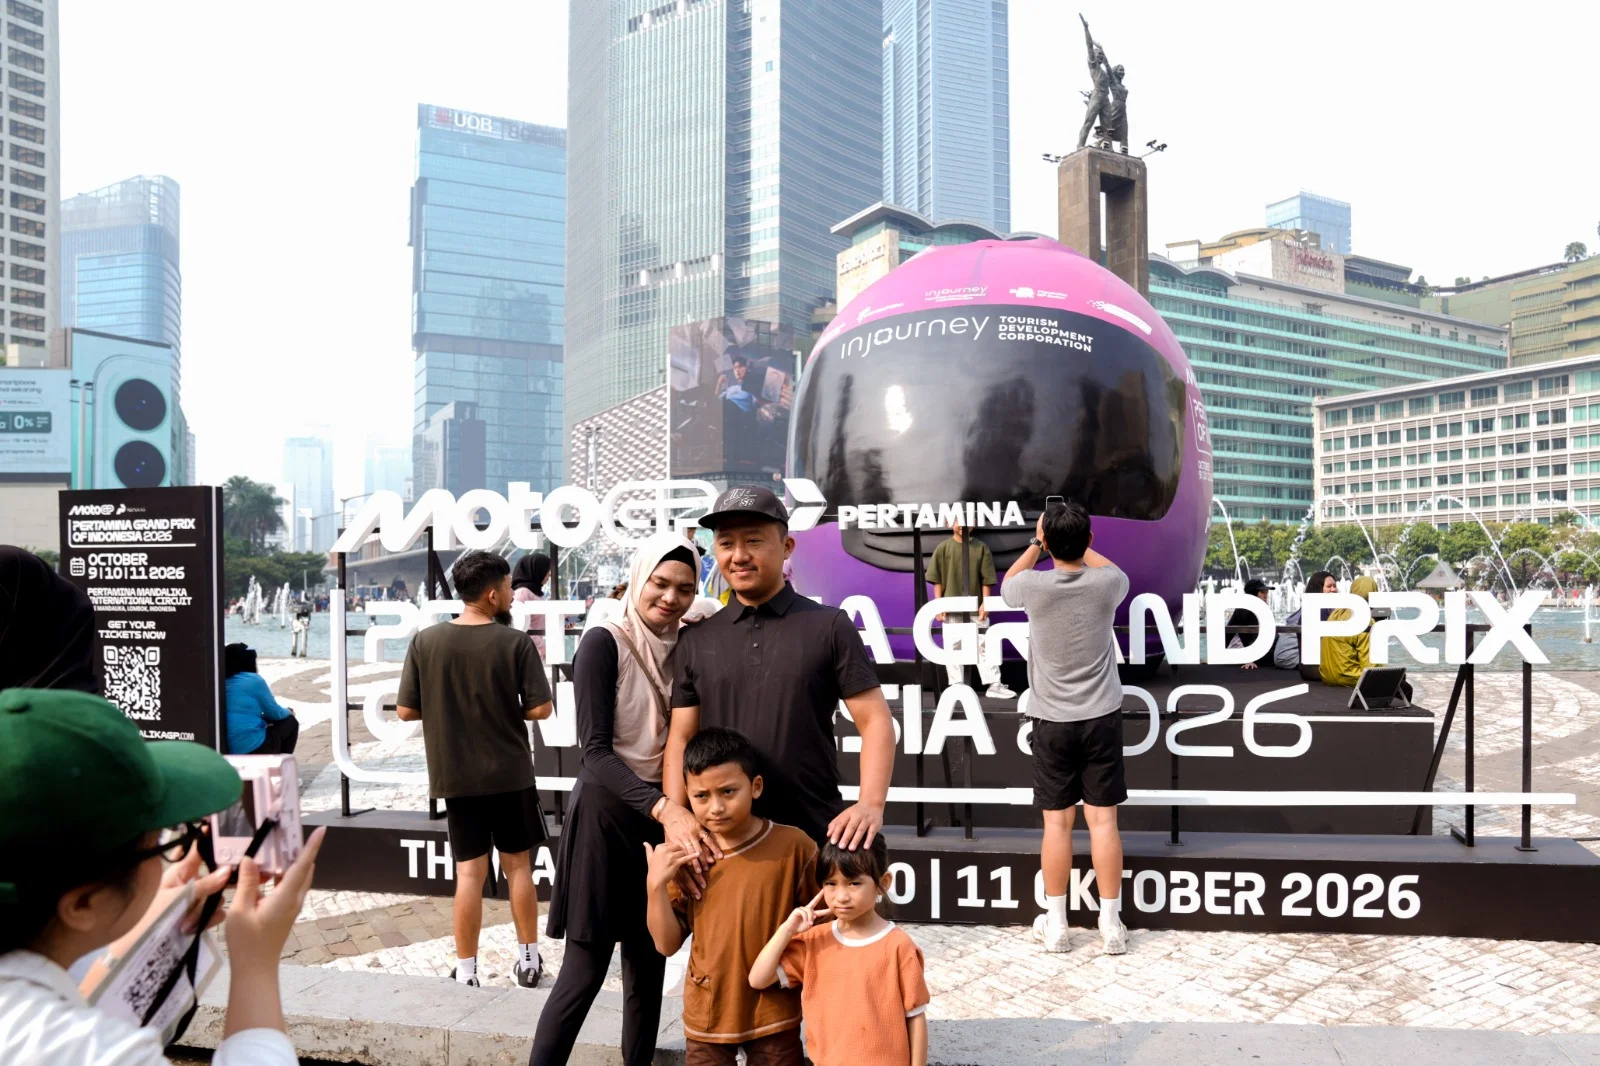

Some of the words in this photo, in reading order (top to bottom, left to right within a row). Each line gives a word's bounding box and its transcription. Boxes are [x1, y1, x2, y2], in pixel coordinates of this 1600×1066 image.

[454, 112, 493, 132] UOB
[1000, 315, 1058, 328] TOURISM
[840, 316, 990, 359] injourney
[998, 324, 1094, 344] DEVELOPMENT
[998, 332, 1092, 353] CORPORATION
[14, 415, 34, 429] 0%
[68, 504, 115, 516] MotoGP
[330, 479, 720, 552] MotoGP
[838, 500, 1025, 530] PERTAMINA
[72, 519, 133, 531] PERTAMINA
[133, 518, 170, 530] GRAND
[170, 518, 196, 530] PRIX
[72, 532, 87, 542] OF
[87, 531, 143, 542] INDONESIA
[143, 530, 173, 541] 2026
[88, 553, 148, 566] OCTOBER
[148, 566, 185, 580] 2026
[87, 587, 136, 597] PERTAMINA
[136, 587, 187, 597] MANDALIKA
[155, 597, 192, 606] CIRCUIT
[107, 620, 128, 629] GET
[128, 620, 156, 630] YOUR
[913, 592, 1275, 665] GRND
[1300, 590, 1550, 665] PRIX
[98, 630, 142, 639] TICKETS
[142, 631, 166, 640] NOW
[139, 729, 195, 741] ALIKAGP.COM
[956, 865, 1019, 908] 11
[1281, 872, 1421, 919] 2026
